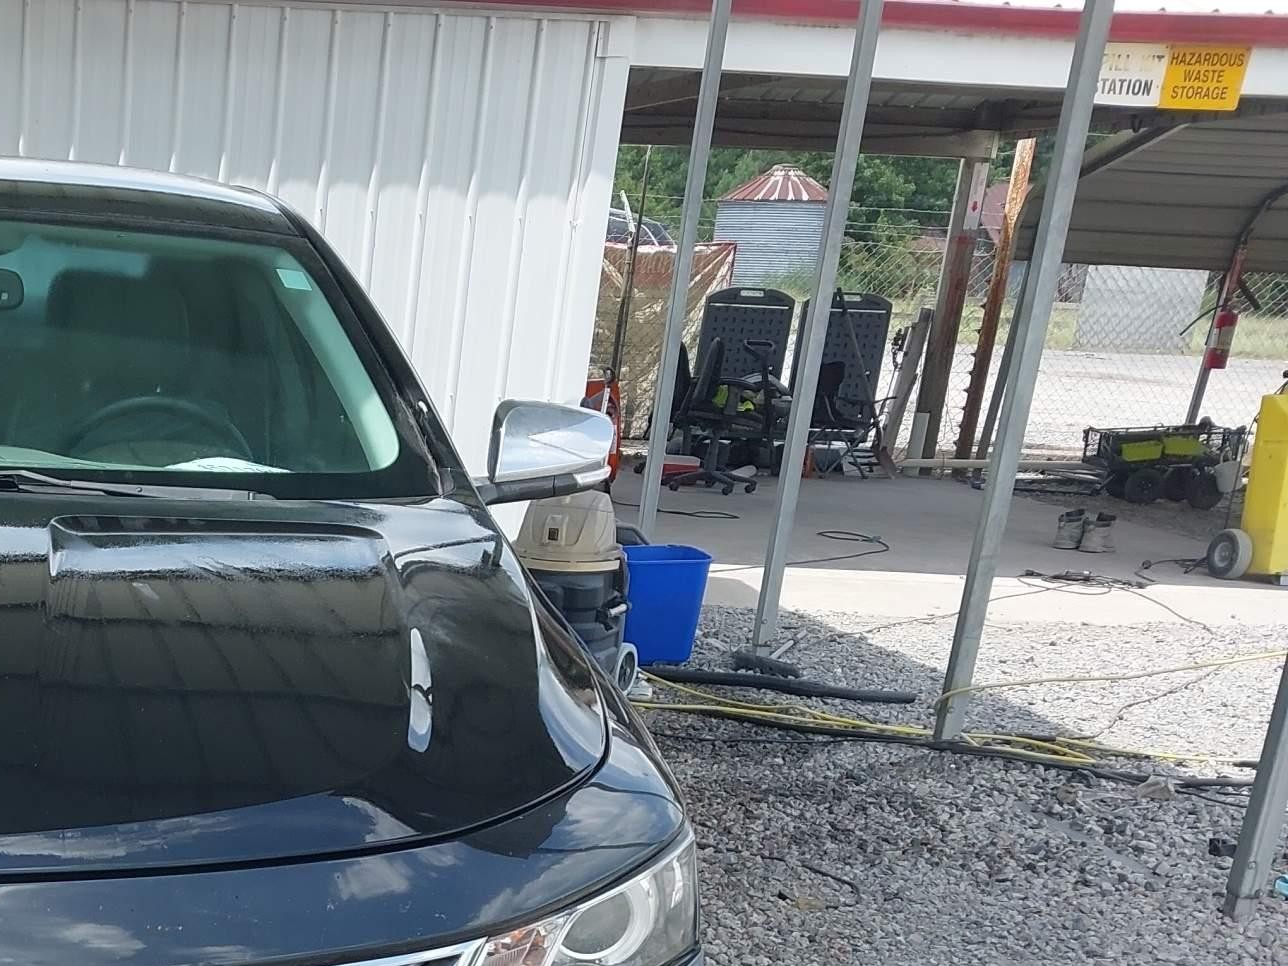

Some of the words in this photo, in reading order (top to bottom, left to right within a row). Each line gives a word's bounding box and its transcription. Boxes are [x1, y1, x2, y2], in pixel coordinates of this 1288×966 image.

[1170, 52, 1245, 67] HAZARDOUS
[1183, 69, 1225, 83] WASTE
[1099, 78, 1154, 96] TATION
[1170, 85, 1229, 100] STORAGE
